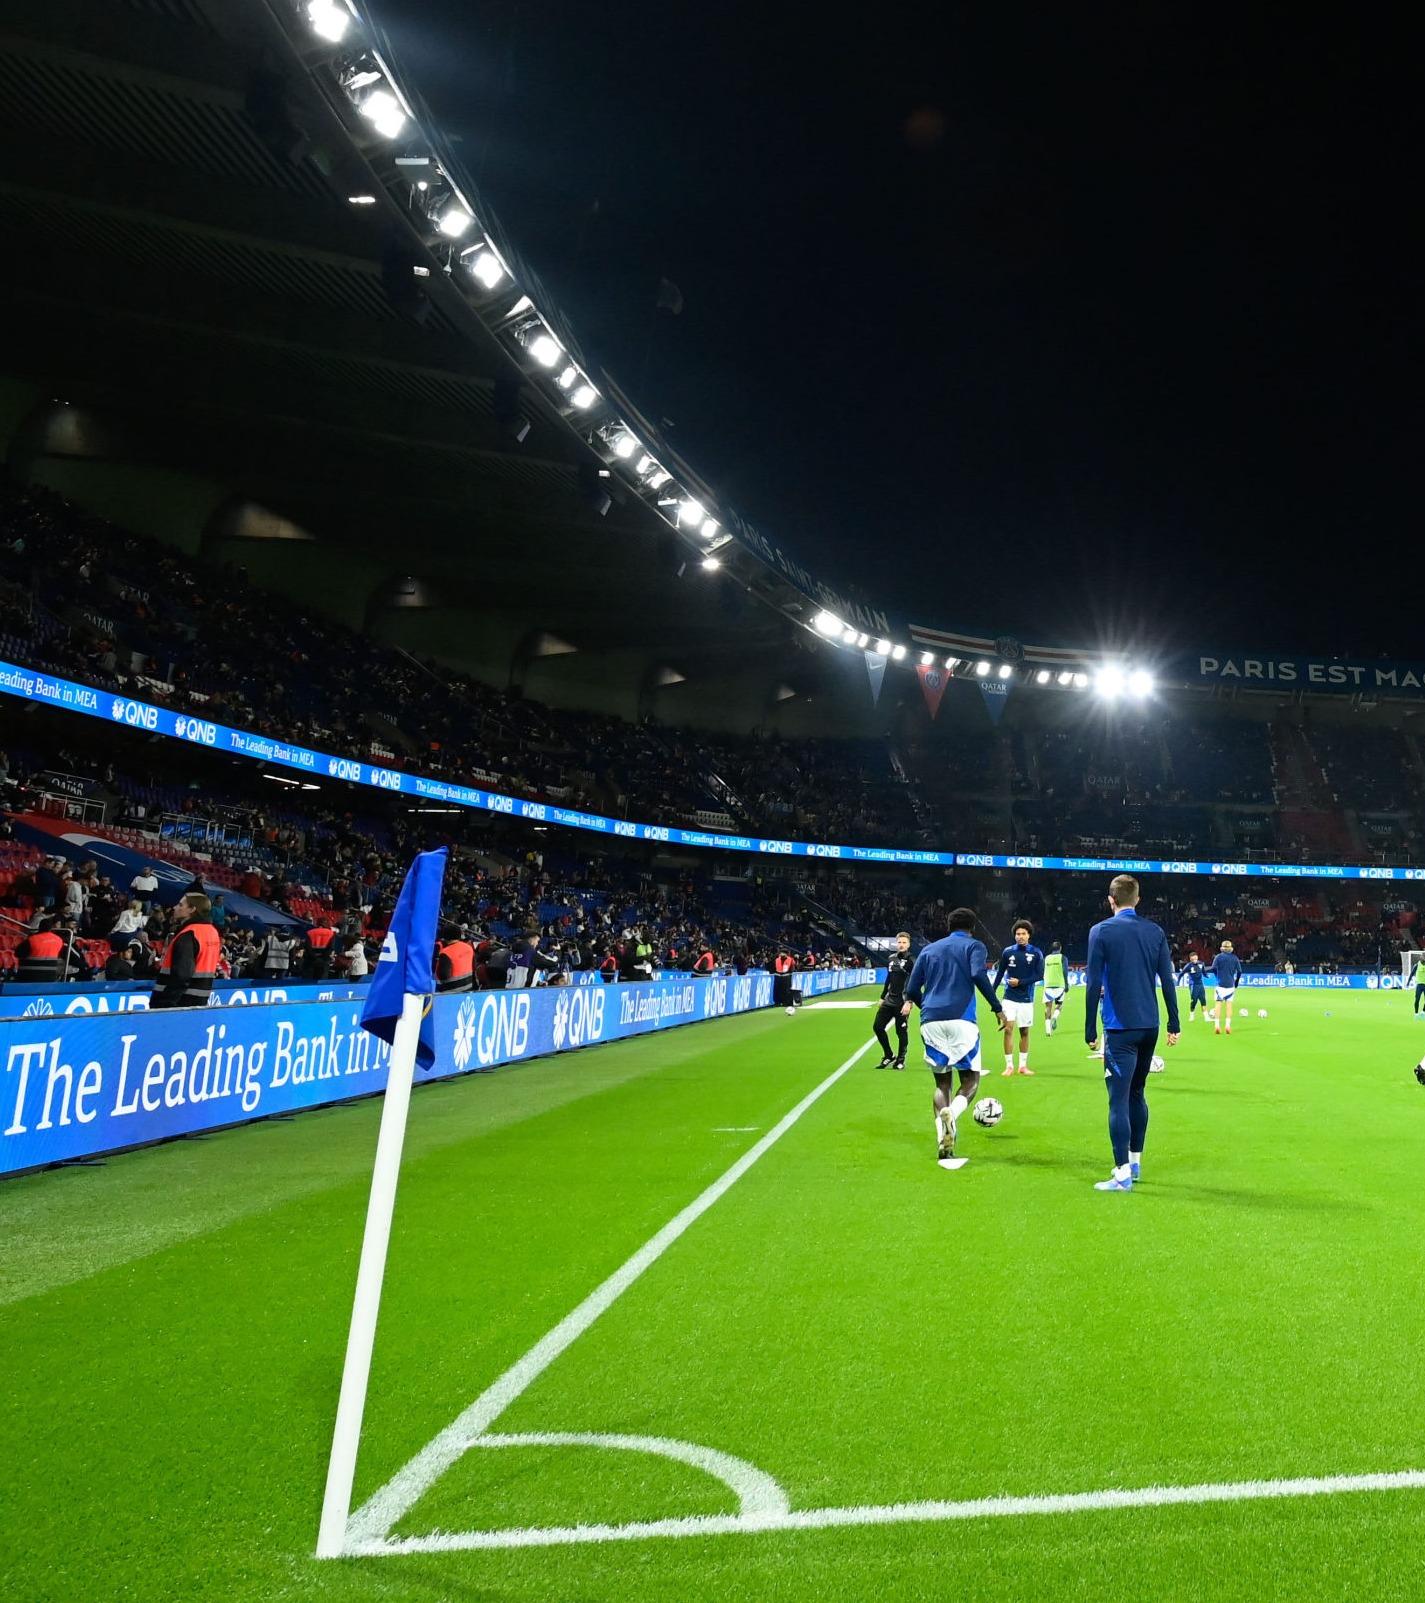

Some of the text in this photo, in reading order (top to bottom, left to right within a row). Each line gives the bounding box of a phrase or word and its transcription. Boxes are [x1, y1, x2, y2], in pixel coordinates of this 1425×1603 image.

[1200, 657, 1297, 680] PARIS
[1308, 664, 1366, 685] EST
[0, 671, 33, 695] eading
[35, 678, 60, 699] Bank
[74, 690, 98, 709] MEA
[981, 682, 1007, 691] QATAR
[125, 702, 158, 728] QNB
[186, 720, 216, 744] QNB
[231, 733, 244, 748] The
[245, 738, 272, 759] Leading
[273, 745, 291, 760] Bank
[300, 752, 314, 766] MEA
[338, 761, 360, 780] QNB
[379, 771, 400, 789] QNB
[1088, 776, 1121, 785] QATAR
[494, 796, 512, 812] QNB
[528, 804, 546, 819] QNB
[620, 823, 636, 836] QNB
[651, 827, 669, 840] QNB
[768, 841, 792, 853] QNB
[816, 845, 840, 857] QNB
[966, 855, 993, 866] QNB
[1016, 857, 1043, 867] QNB
[1171, 863, 1197, 872] QNB
[1222, 864, 1247, 874] QNB
[1369, 868, 1393, 878] QNB
[1248, 899, 1270, 907] QATAR
[1383, 903, 1405, 911] QATAR
[1247, 974, 1286, 989] Leading
[1287, 975, 1313, 986] Bank
[1313, 975, 1325, 986] in
[1327, 976, 1351, 986] MEA
[711, 979, 727, 1014] QNB
[739, 977, 752, 1010] QNB
[620, 992, 635, 1025] The
[634, 987, 661, 1026] Leading
[660, 985, 676, 1018] Bank
[682, 985, 695, 1013] MEA
[568, 988, 605, 1046] QNB
[477, 993, 530, 1065] QNB
[4, 1037, 103, 1136] The
[110, 1024, 268, 1117] Leading
[269, 1015, 348, 1089] Bank
[347, 1013, 371, 1075] in
